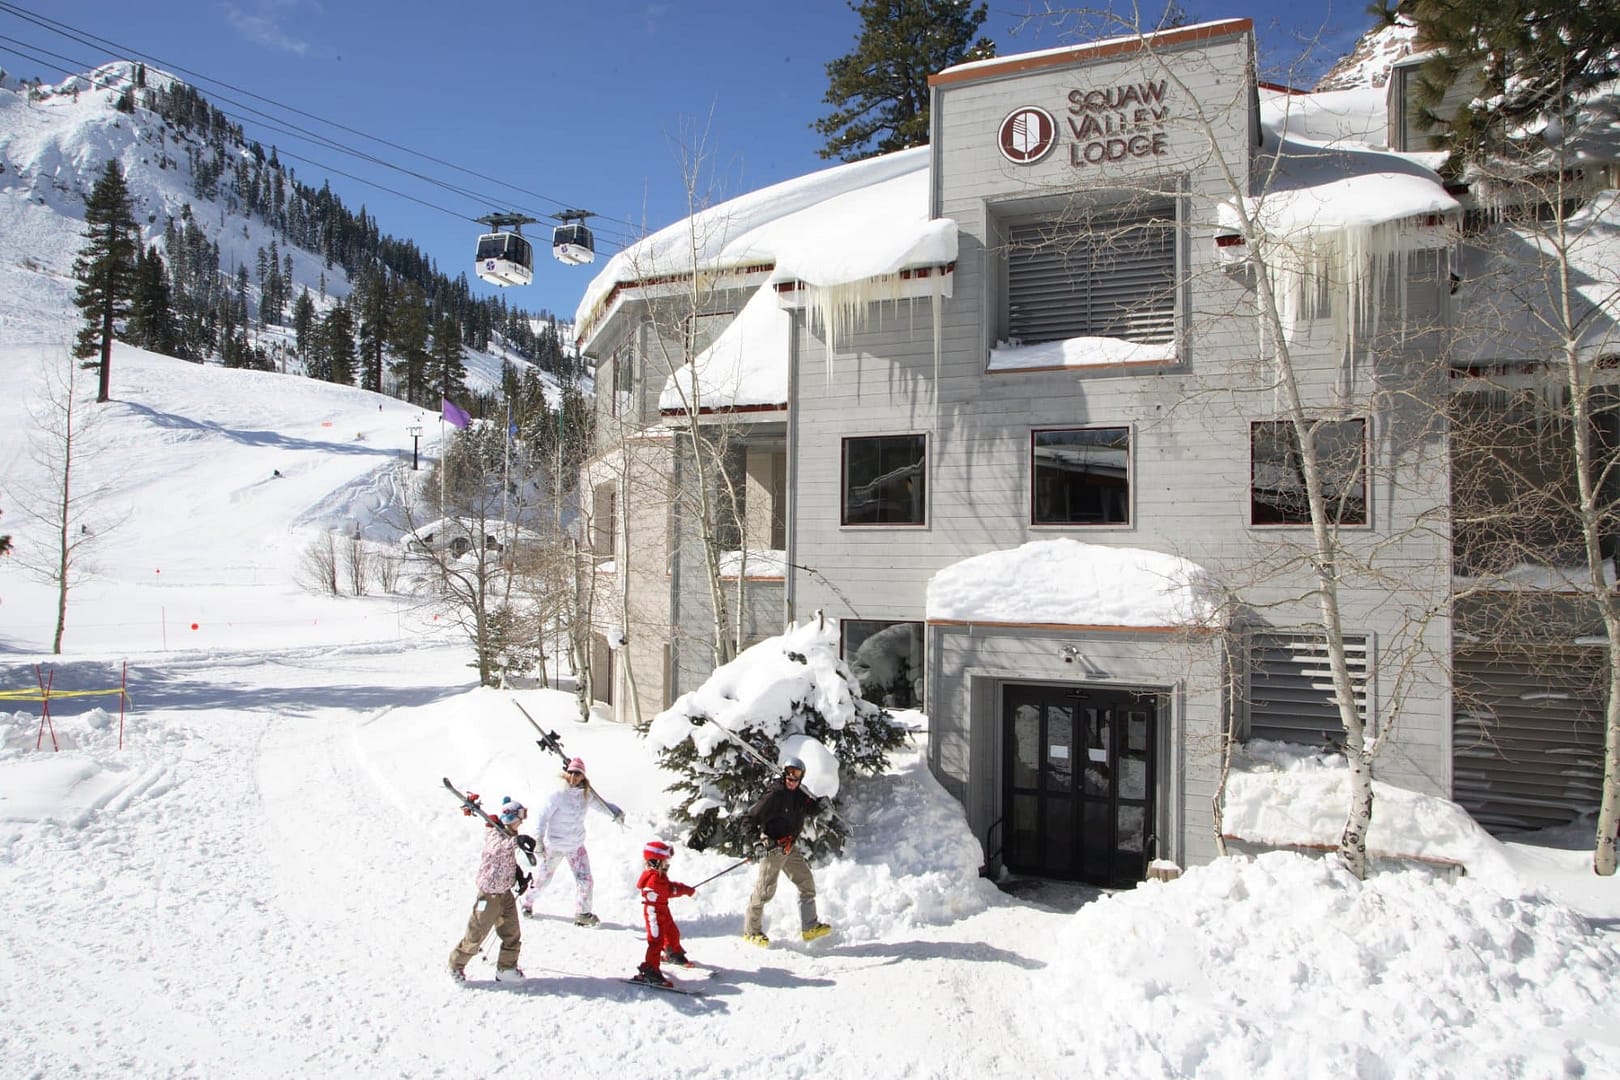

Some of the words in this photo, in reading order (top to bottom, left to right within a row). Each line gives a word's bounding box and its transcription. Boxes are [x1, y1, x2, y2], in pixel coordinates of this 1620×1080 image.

[1067, 79, 1167, 115] SQUAW
[1067, 105, 1168, 140] VALLEY
[1070, 132, 1167, 167] LODGE
